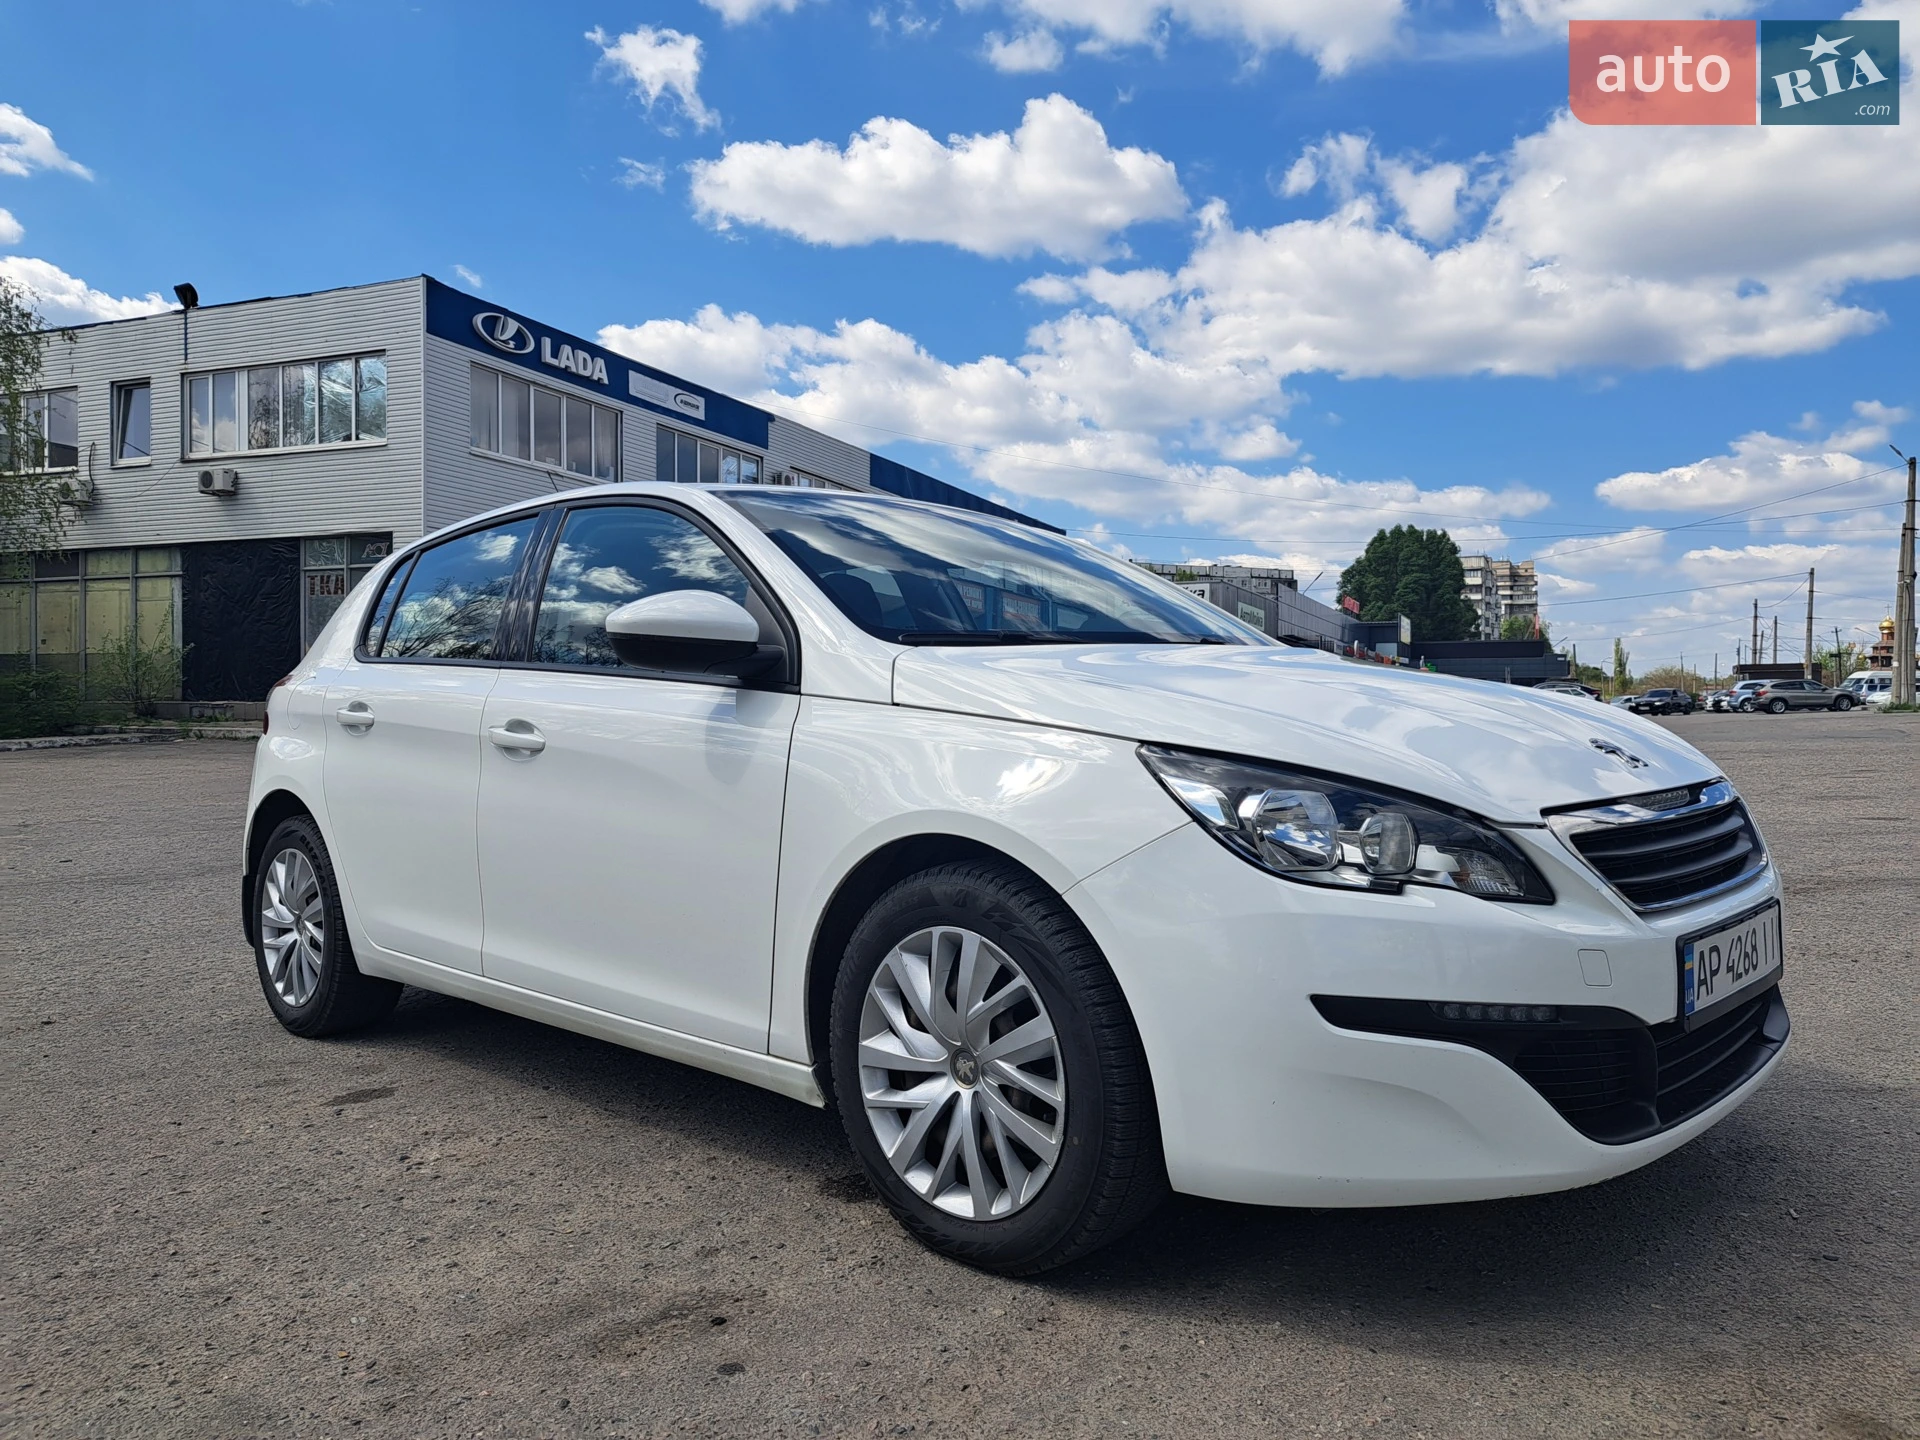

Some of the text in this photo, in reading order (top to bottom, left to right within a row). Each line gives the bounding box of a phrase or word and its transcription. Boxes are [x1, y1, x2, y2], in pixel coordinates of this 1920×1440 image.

[541, 336, 609, 385] LADA
[1696, 945, 1721, 1001] AP
[1726, 928, 1759, 984] 4268
[1685, 988, 1694, 1004] UA
